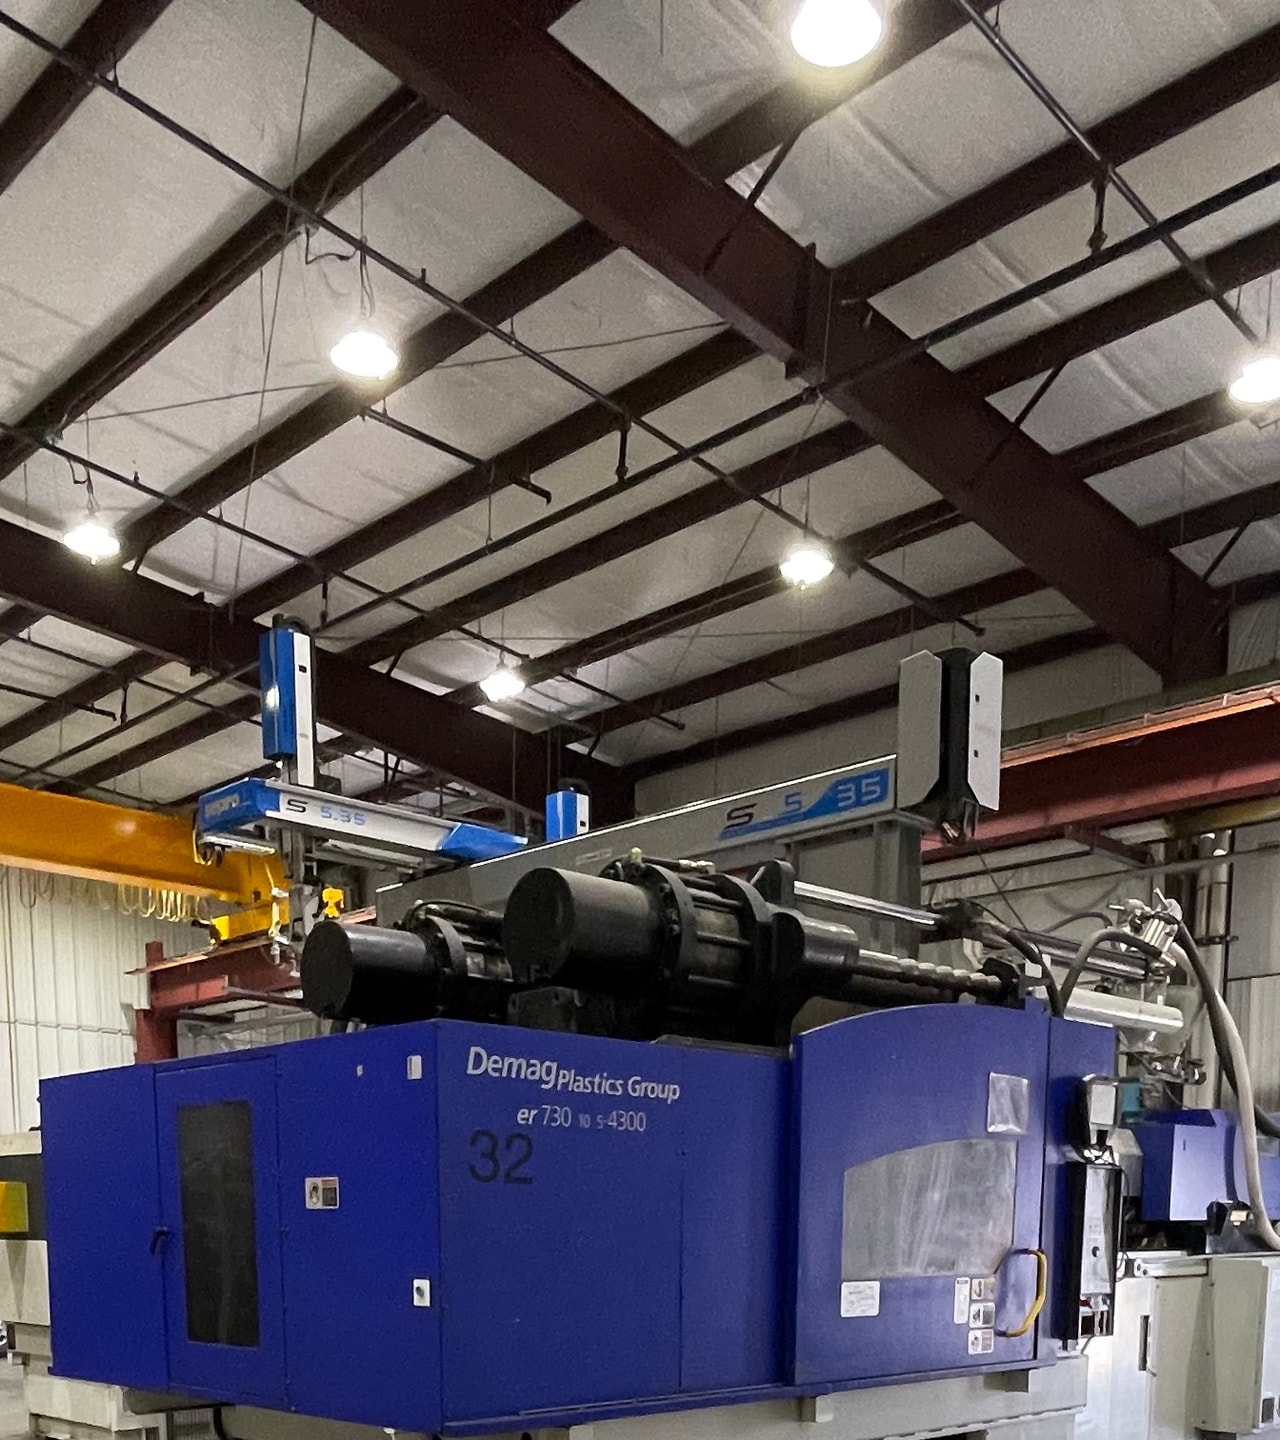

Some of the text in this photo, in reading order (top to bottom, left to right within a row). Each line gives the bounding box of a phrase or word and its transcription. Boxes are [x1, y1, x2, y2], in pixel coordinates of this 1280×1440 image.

[286, 798, 367, 827] S 5.35
[723, 776, 882, 829] S 5 35
[466, 1046, 681, 1104] Demag Plastics Group
[516, 1107, 539, 1125] er
[540, 1104, 572, 1127] 730
[468, 1129, 534, 1185] 32
